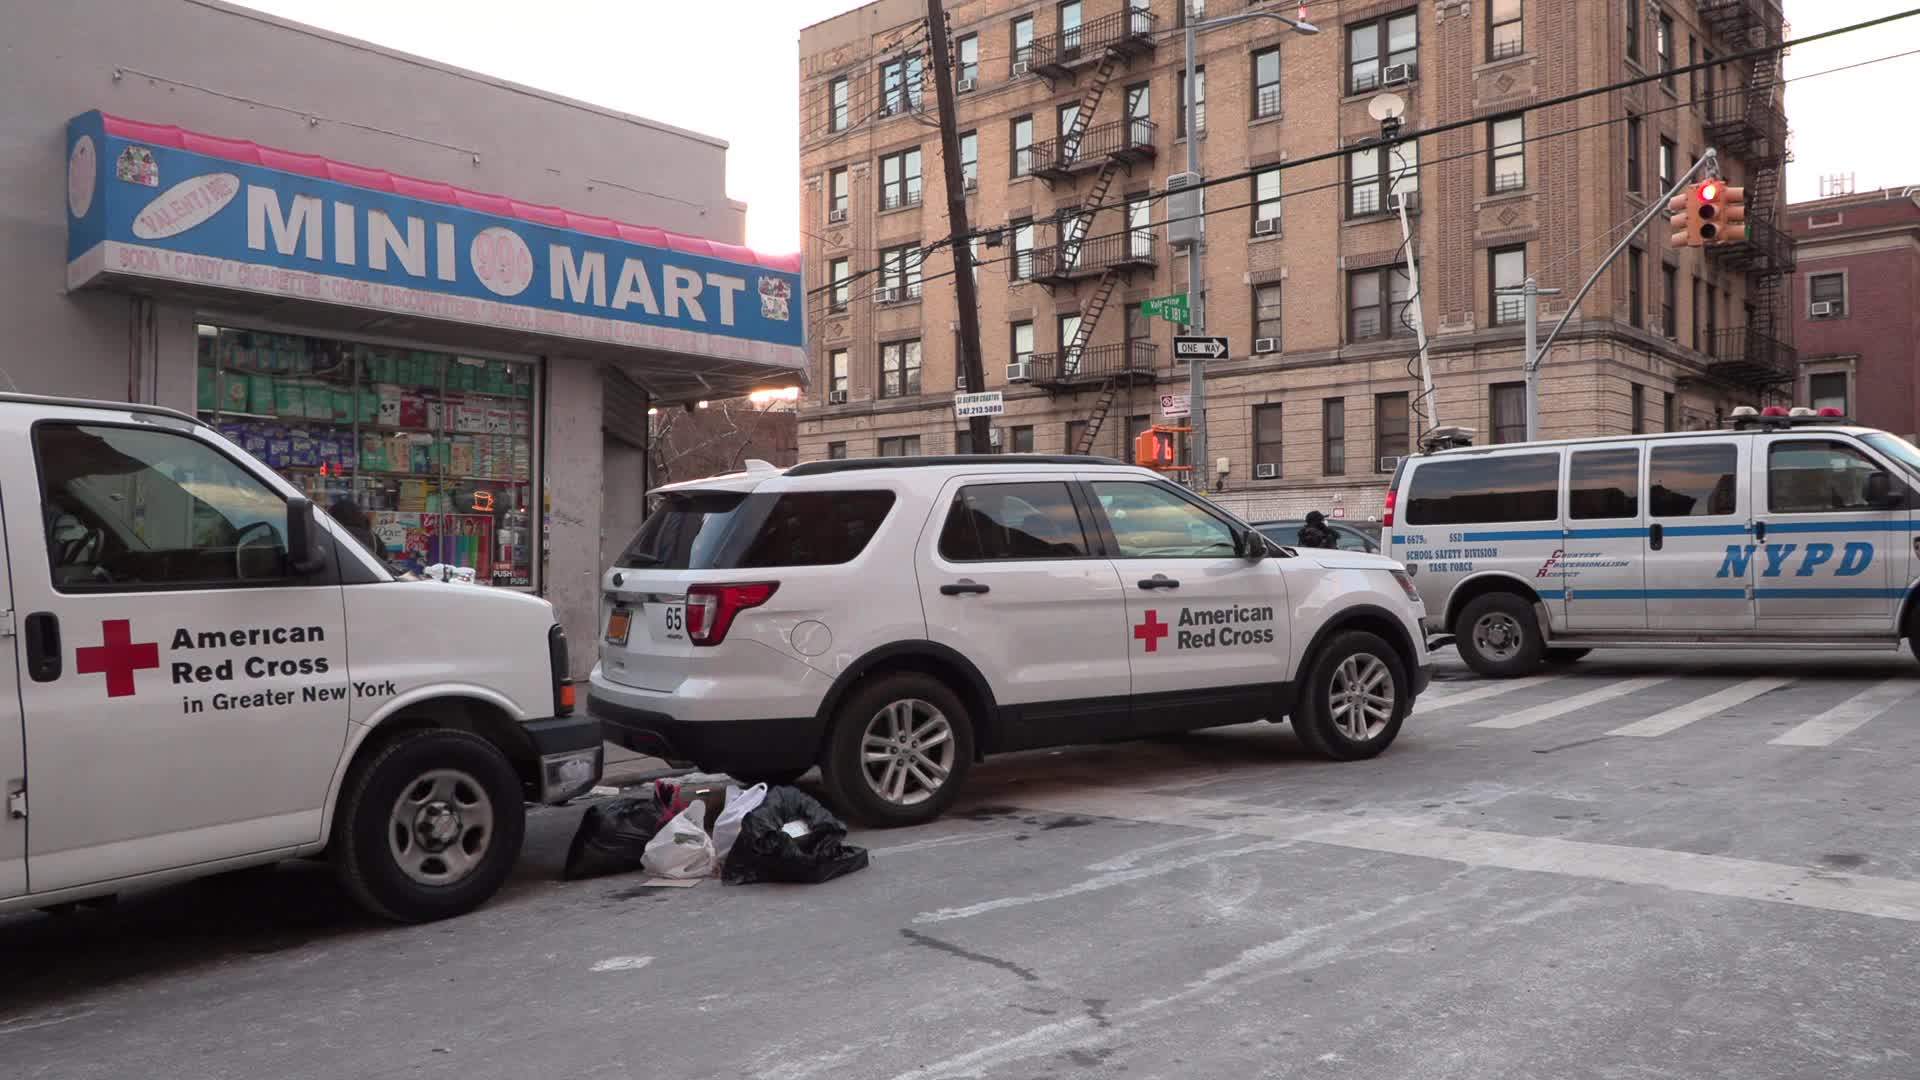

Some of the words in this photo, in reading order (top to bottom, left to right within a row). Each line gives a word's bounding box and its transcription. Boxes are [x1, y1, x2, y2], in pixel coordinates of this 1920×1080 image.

[247, 184, 456, 282] MINI
[119, 247, 160, 269] SODA
[175, 255, 223, 280] CANDY
[549, 243, 745, 326] MART
[1165, 305, 1169, 319] E
[1182, 344, 1198, 353] ONE
[1204, 343, 1220, 353] WAY
[1449, 532, 1462, 542] SSD
[1406, 550, 1433, 560] SCHOOL
[1435, 549, 1462, 559] SAFETY
[1464, 547, 1497, 558] DIVISION
[1715, 542, 1874, 578] NYPD
[1429, 563, 1448, 572] TASK
[1450, 562, 1473, 571] FORCE
[666, 607, 682, 630] 65
[1178, 604, 1273, 627] American
[171, 625, 325, 650] American
[1178, 629, 1215, 649] Red
[1219, 627, 1273, 646] Cross
[172, 660, 233, 684] Red
[245, 656, 329, 679] Cross
[183, 696, 203, 714] in
[212, 688, 295, 712] Greater
[302, 686, 346, 703] New
[352, 681, 397, 699] York
